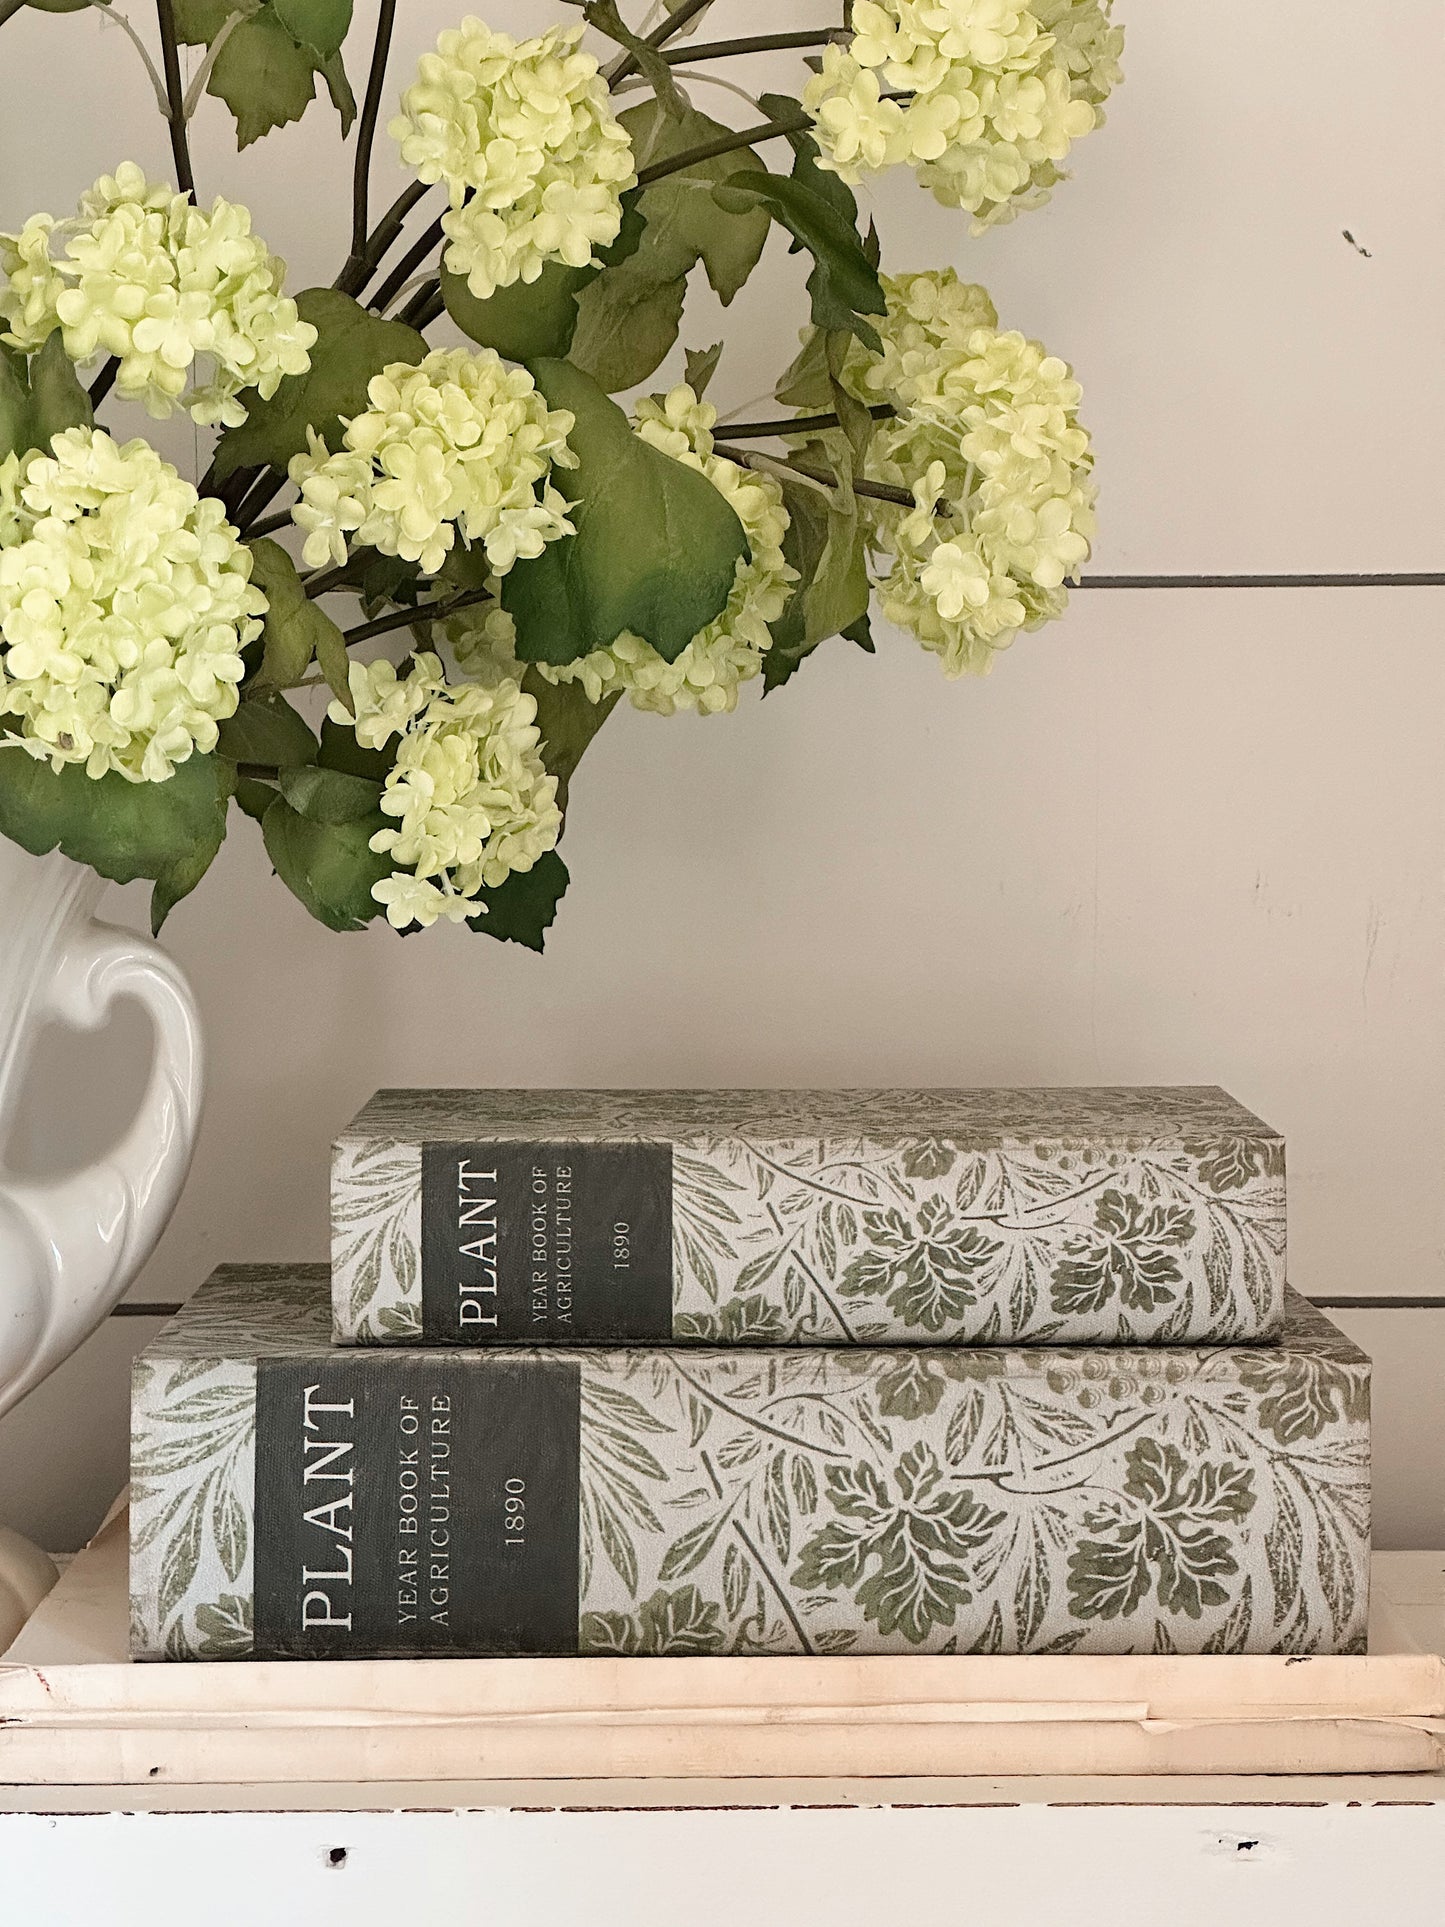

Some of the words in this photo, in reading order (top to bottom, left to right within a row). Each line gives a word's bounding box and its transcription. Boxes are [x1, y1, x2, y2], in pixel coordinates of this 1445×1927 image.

[532, 1166, 548, 1194] OF
[458, 1159, 498, 1328] PLANT
[532, 1203, 548, 1262] BOOK
[556, 1166, 573, 1324] AGRICULTURE
[613, 1222, 630, 1269] 1890
[532, 1270, 548, 1323] YEAR
[400, 1395, 420, 1435] OF
[302, 1384, 354, 1632] PLANT
[399, 1449, 419, 1534] BOOK
[430, 1395, 451, 1627] AGRICULTURE
[504, 1477, 526, 1546] 1890
[398, 1549, 418, 1625] YEAR
